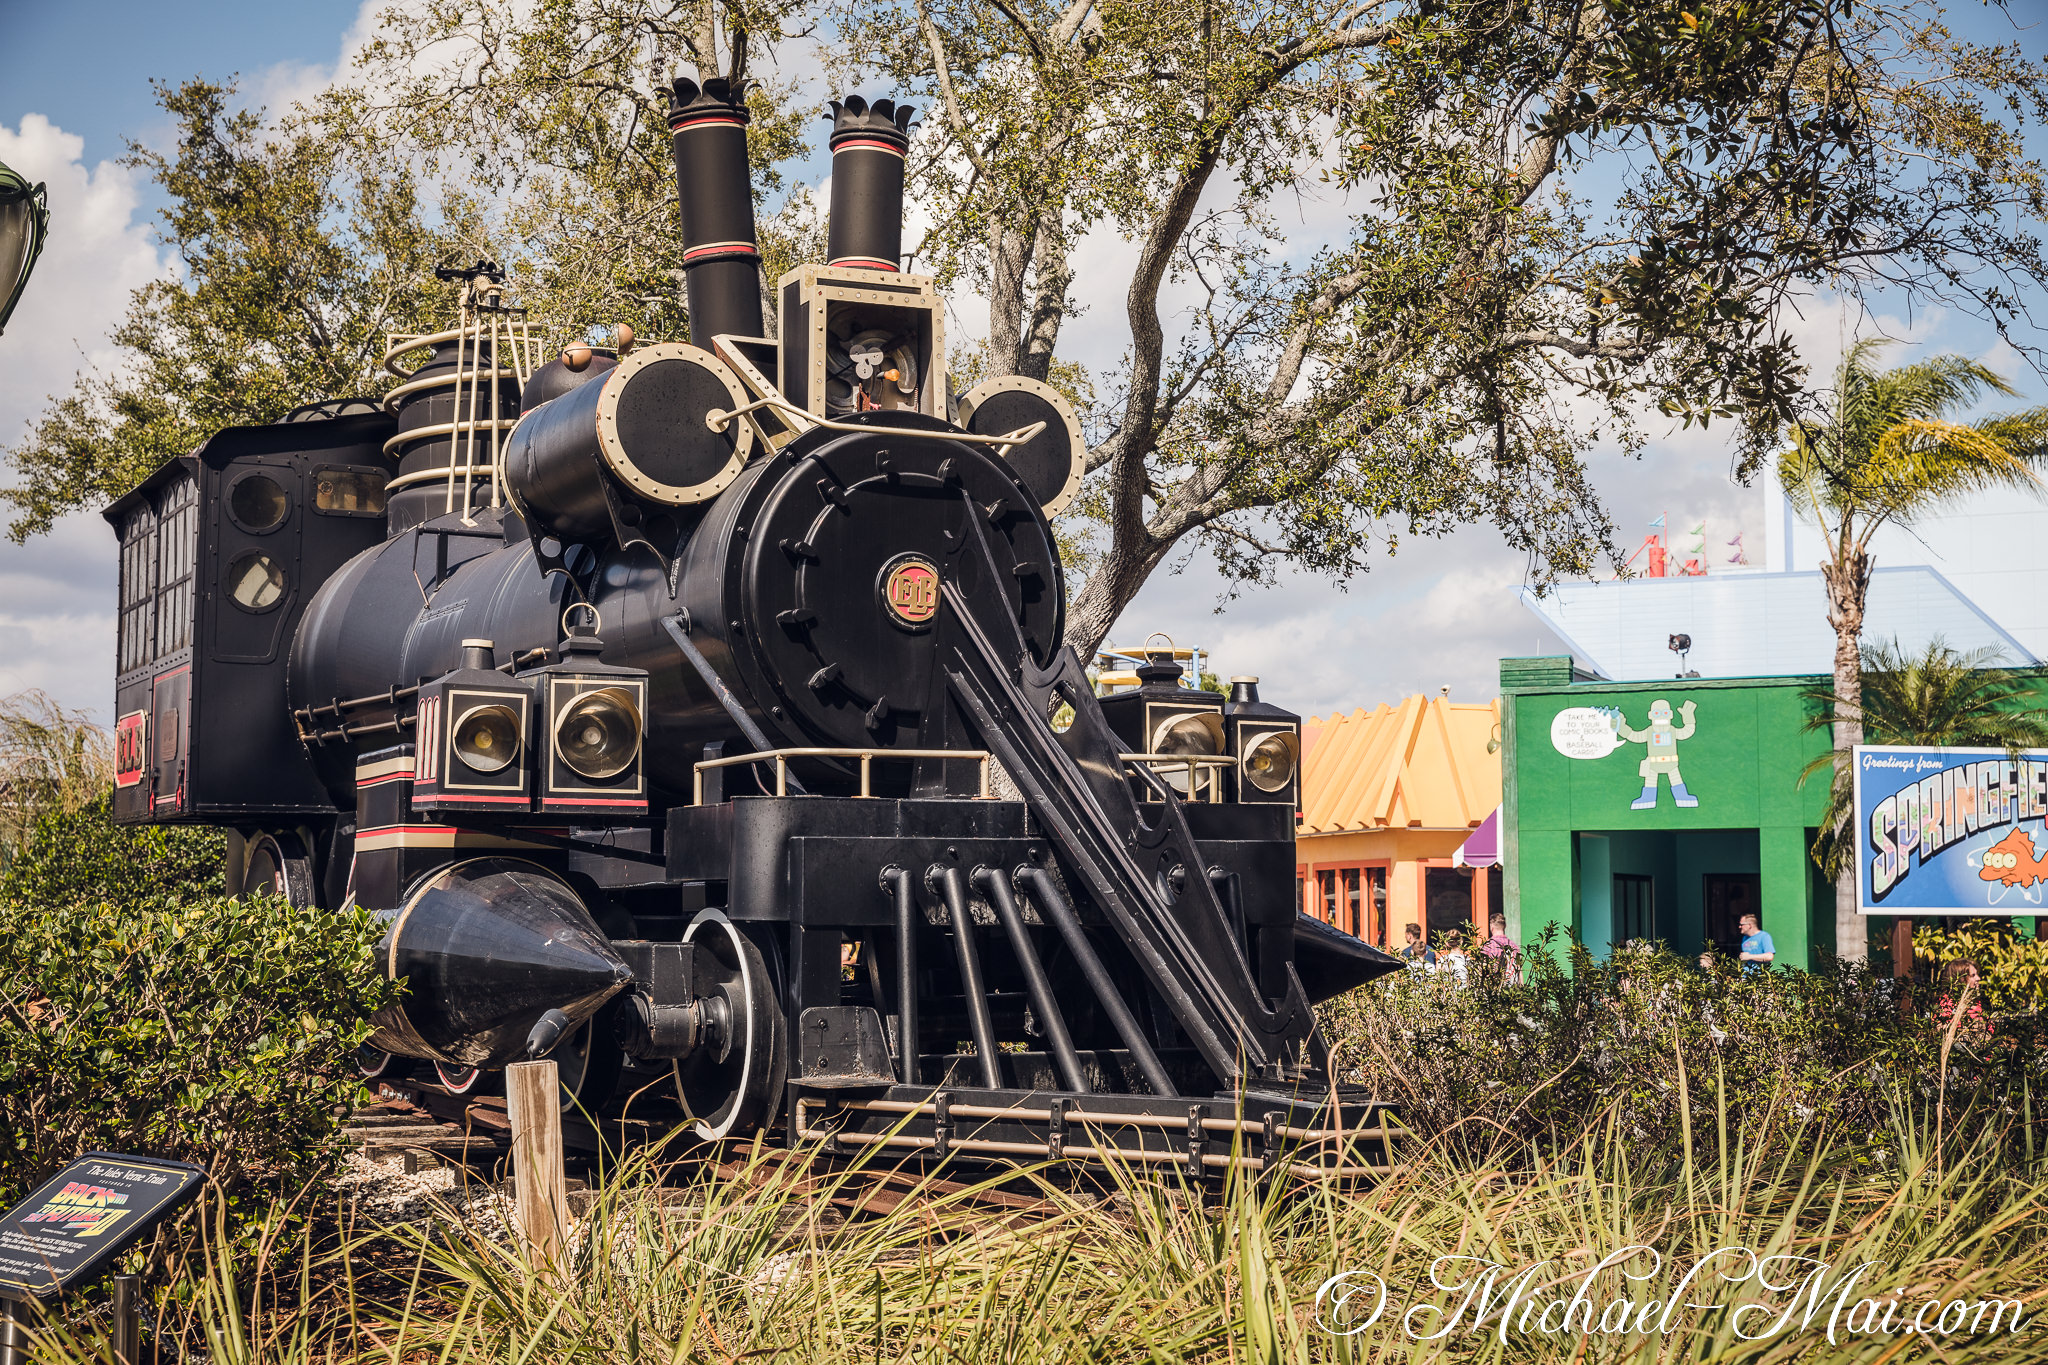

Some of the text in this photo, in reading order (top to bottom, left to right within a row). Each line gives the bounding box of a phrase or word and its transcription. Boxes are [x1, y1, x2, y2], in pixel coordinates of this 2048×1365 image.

[1566, 741, 1603, 749] BASEBALL
[1862, 754, 1943, 773] Greetings from
[1870, 760, 2048, 902] SPRINGFIE
[86, 1165, 168, 1186] The Jules Verne Train
[48, 1181, 114, 1208] BACK
[37, 1205, 110, 1222] FUTURE
